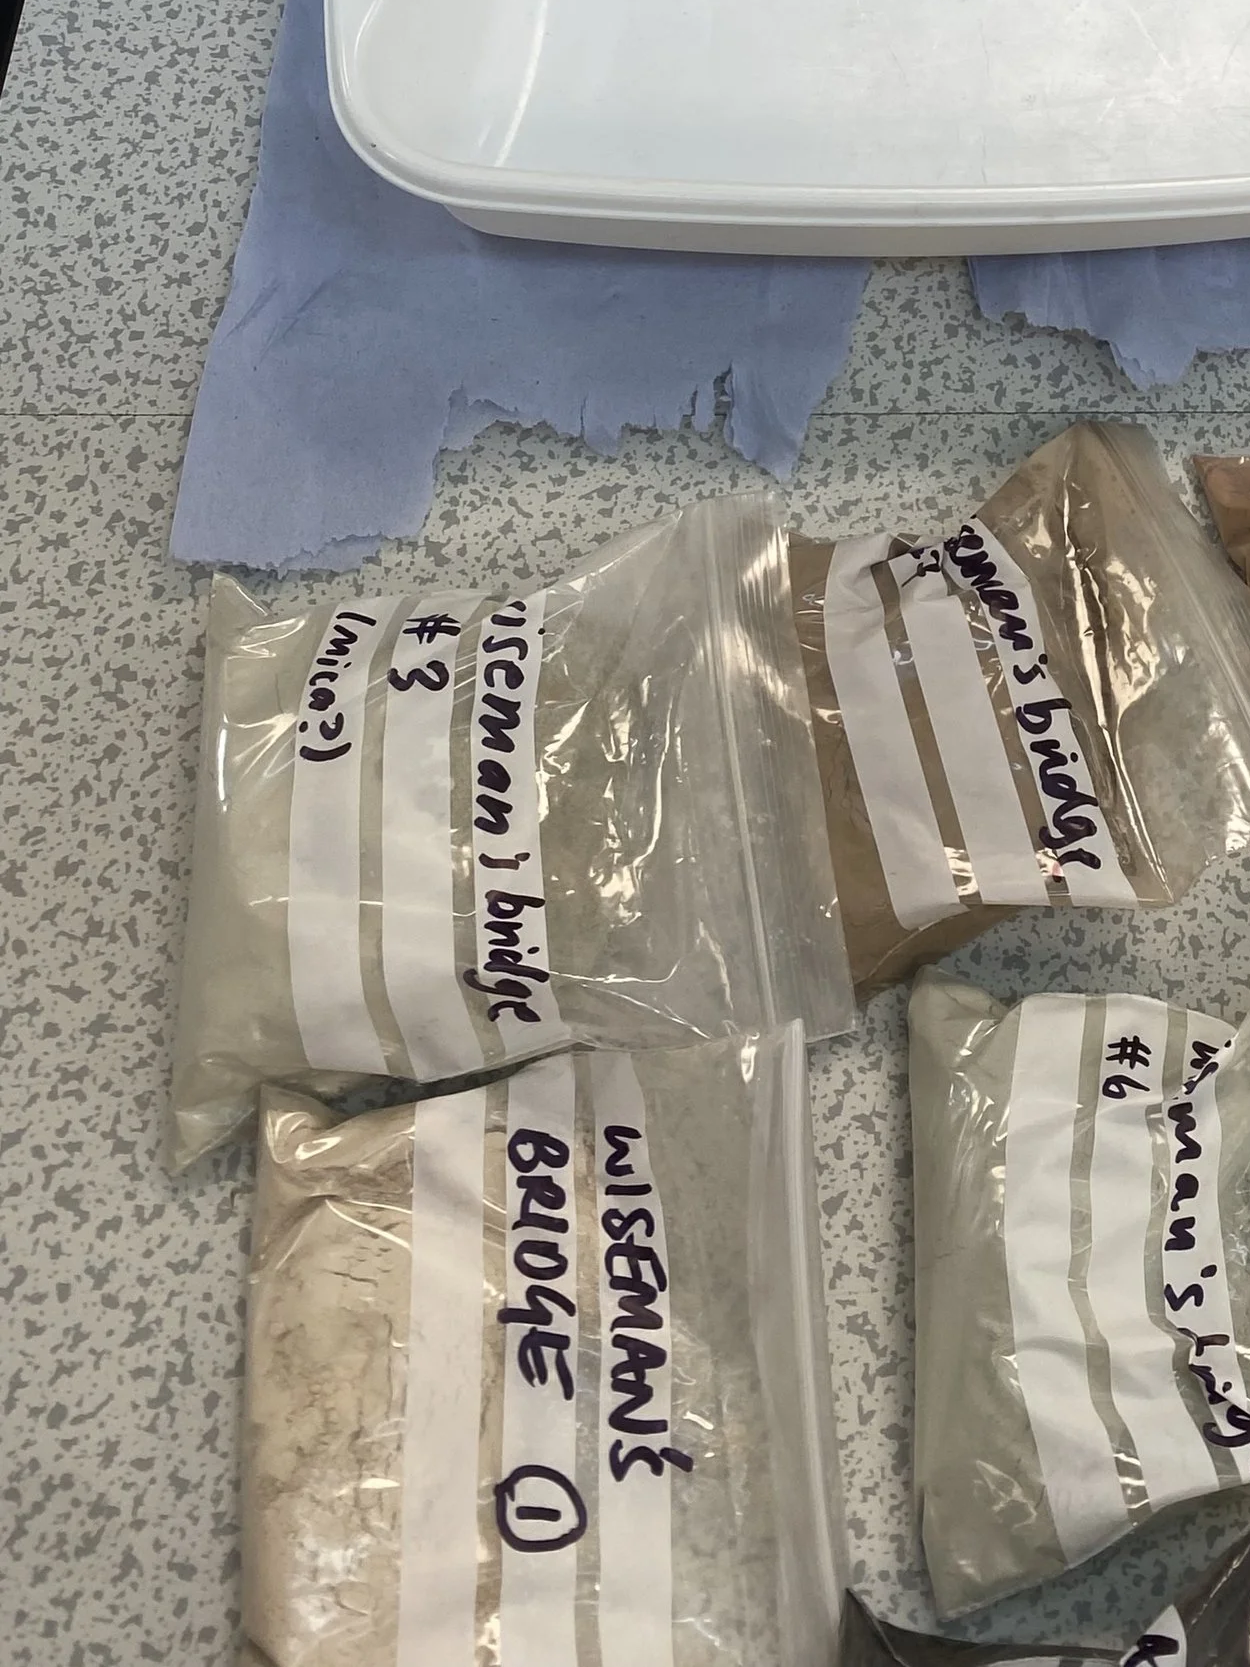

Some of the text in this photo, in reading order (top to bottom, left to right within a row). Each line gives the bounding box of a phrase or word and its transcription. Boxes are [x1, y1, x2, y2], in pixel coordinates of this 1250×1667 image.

[462, 600, 549, 1023] iseman's bridge
[1017, 698, 1102, 883] bridge
